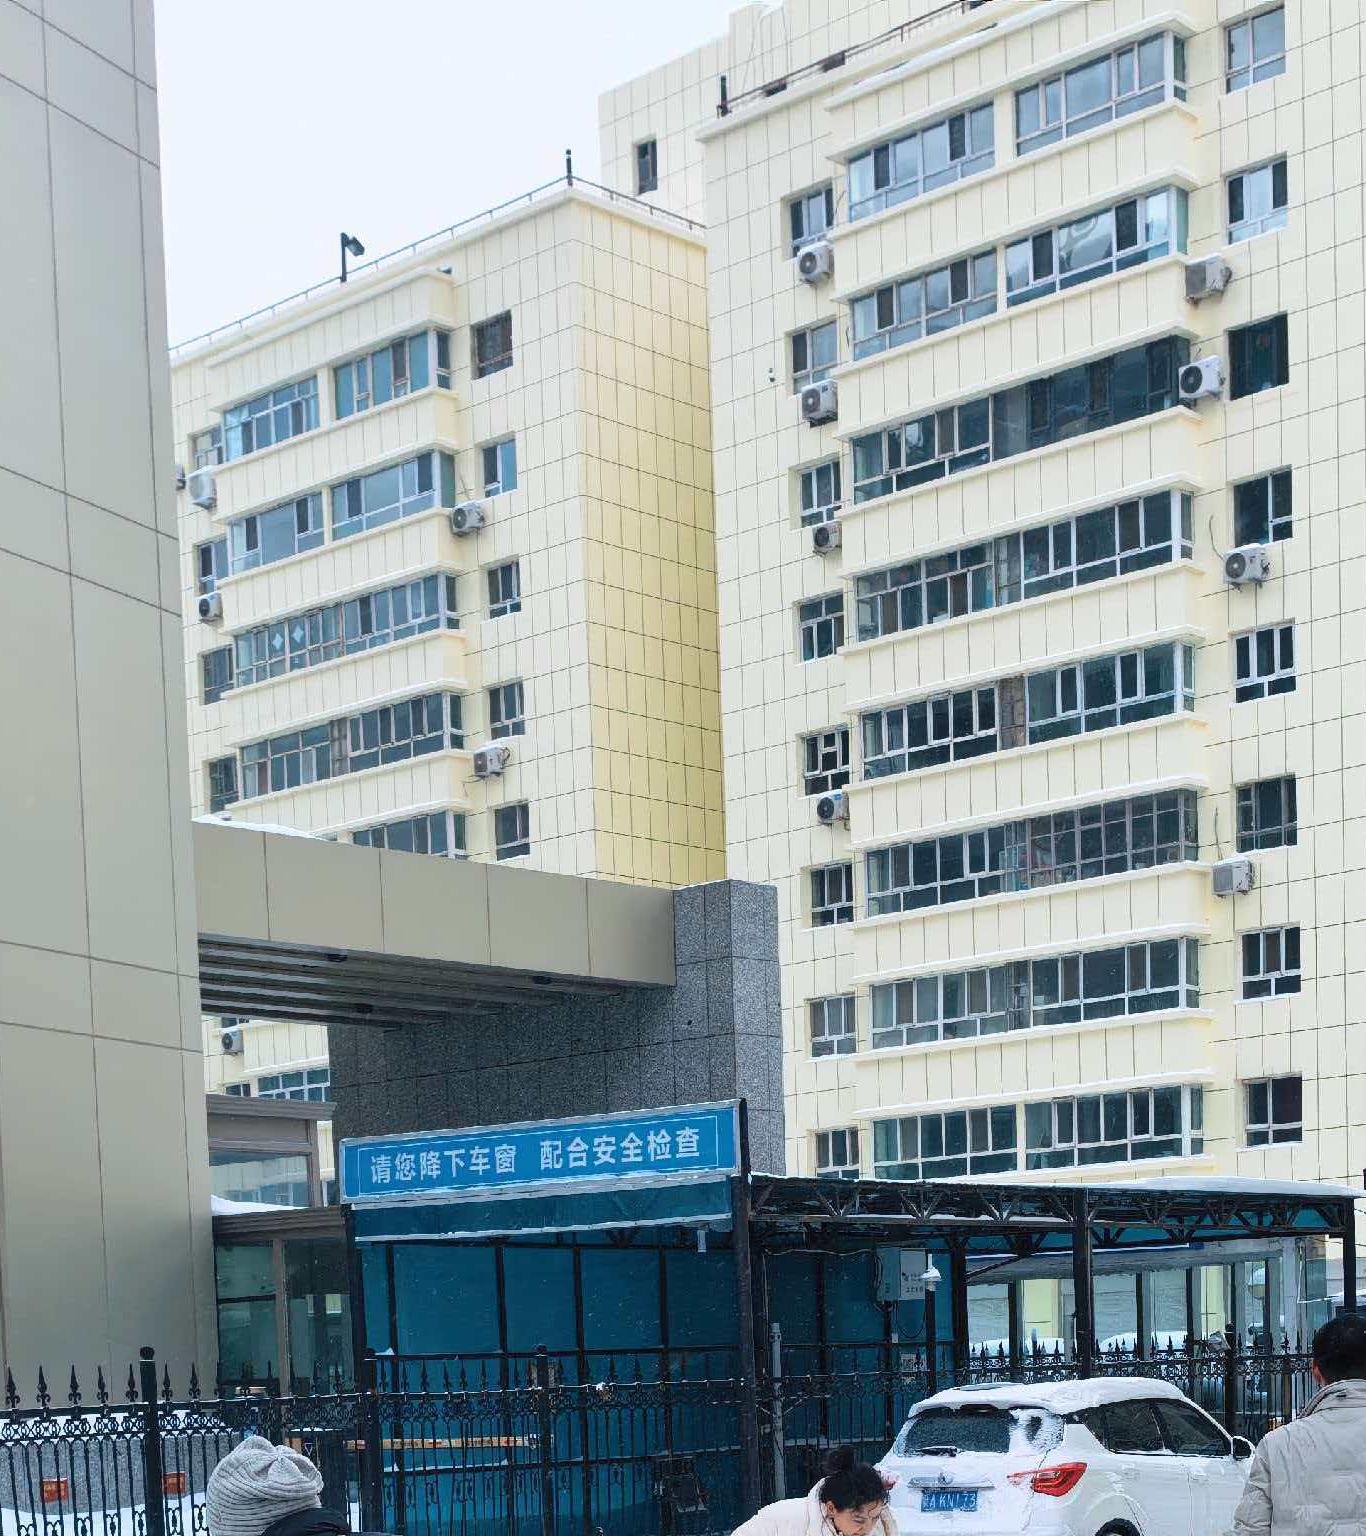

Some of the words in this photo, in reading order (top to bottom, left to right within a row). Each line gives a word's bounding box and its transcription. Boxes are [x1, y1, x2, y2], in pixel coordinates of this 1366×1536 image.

[371, 1143, 518, 1184] 请您降下车窗
[540, 1126, 701, 1170] 配合安全检查
